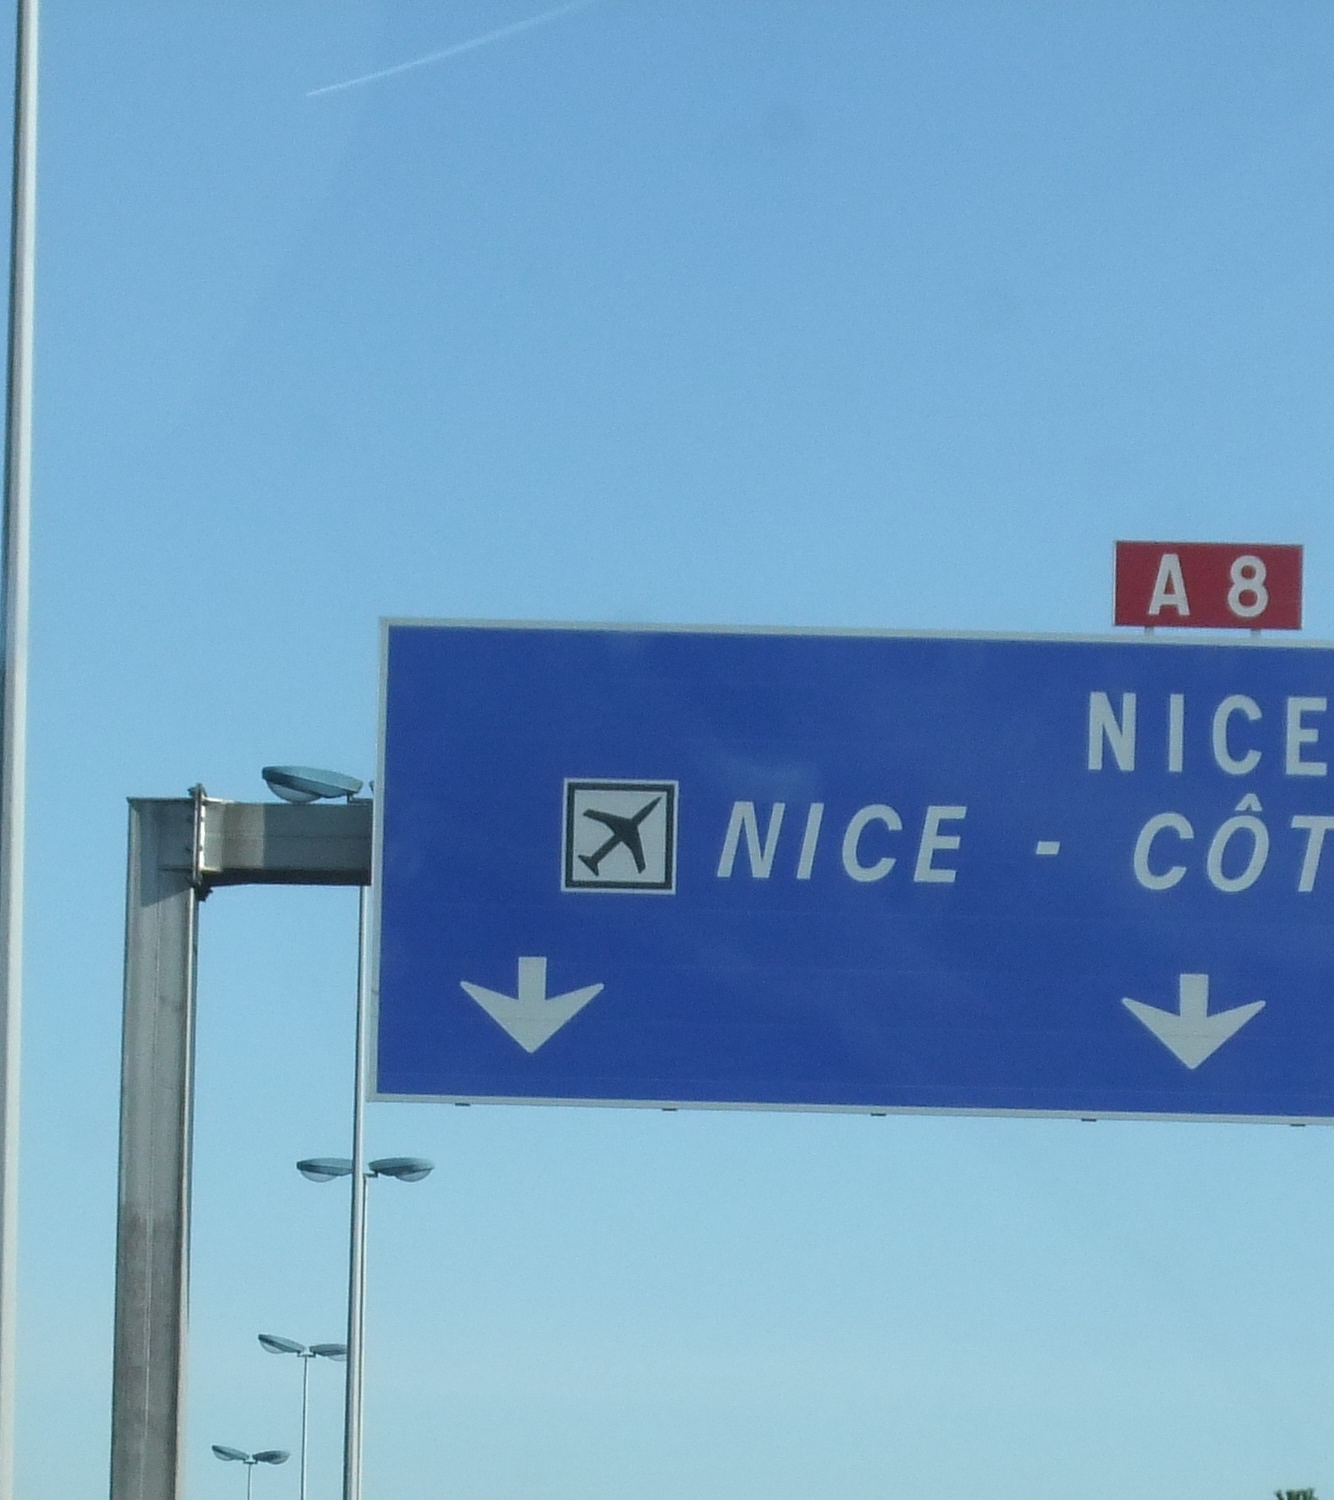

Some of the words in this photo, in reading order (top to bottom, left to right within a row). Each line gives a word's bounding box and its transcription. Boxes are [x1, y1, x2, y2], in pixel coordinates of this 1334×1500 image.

[1147, 553, 1191, 617] A
[1227, 554, 1269, 619] 8
[1087, 691, 1329, 778] NICE
[716, 800, 968, 883] NICE
